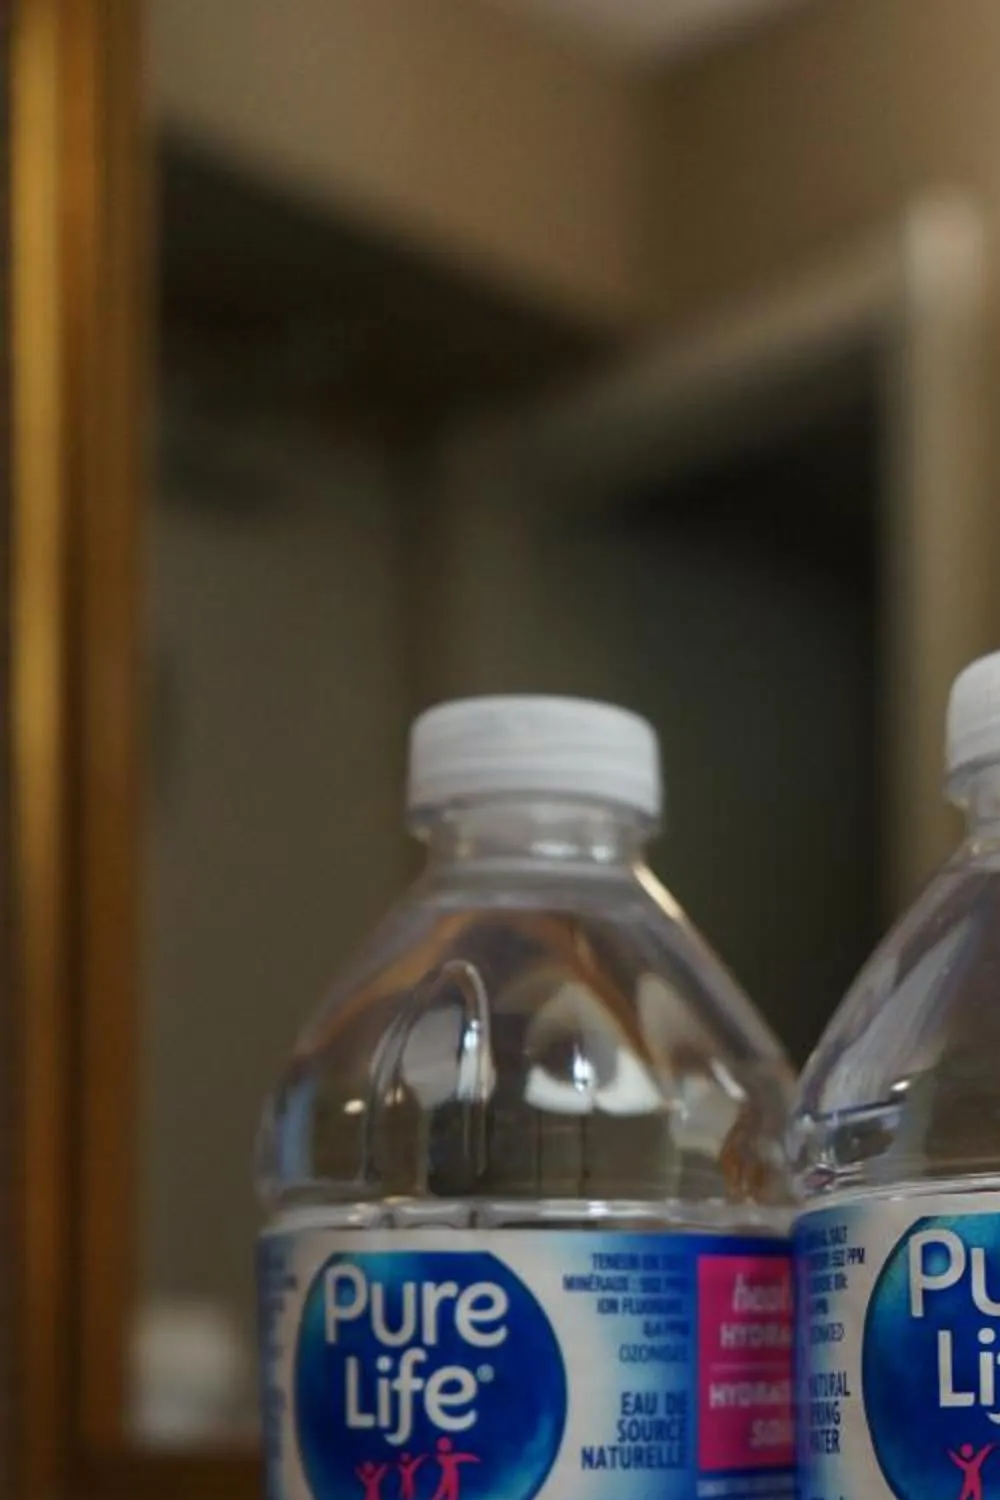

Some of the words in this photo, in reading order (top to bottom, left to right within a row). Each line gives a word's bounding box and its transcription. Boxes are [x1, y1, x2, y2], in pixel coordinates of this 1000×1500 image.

[324, 1263, 509, 1347] Pure
[621, 1391, 658, 1416] EAU
[664, 1391, 687, 1416] DE
[616, 1419, 687, 1443] SOURCE
[581, 1446, 687, 1470] NATURELLE
